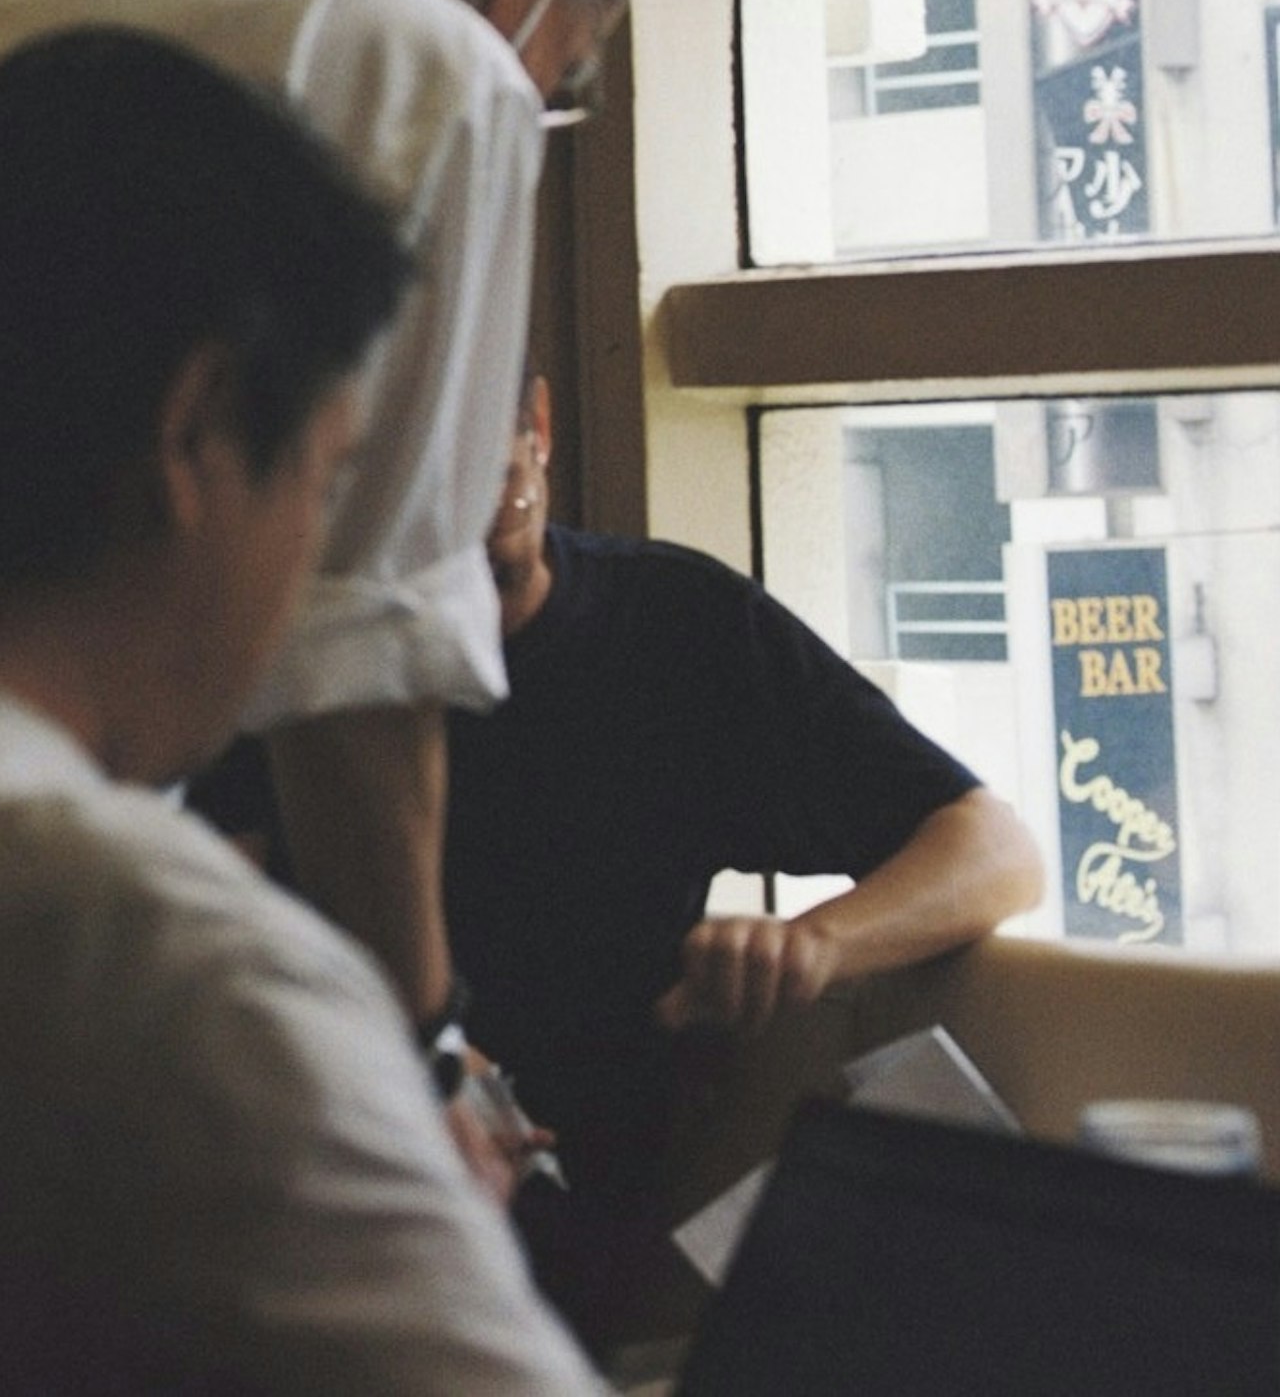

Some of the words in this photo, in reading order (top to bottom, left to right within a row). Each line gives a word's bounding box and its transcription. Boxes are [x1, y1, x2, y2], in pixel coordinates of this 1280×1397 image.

[1083, 65, 1142, 236] 美少
[1051, 595, 1164, 646] BEER
[1079, 647, 1166, 698] BAR
